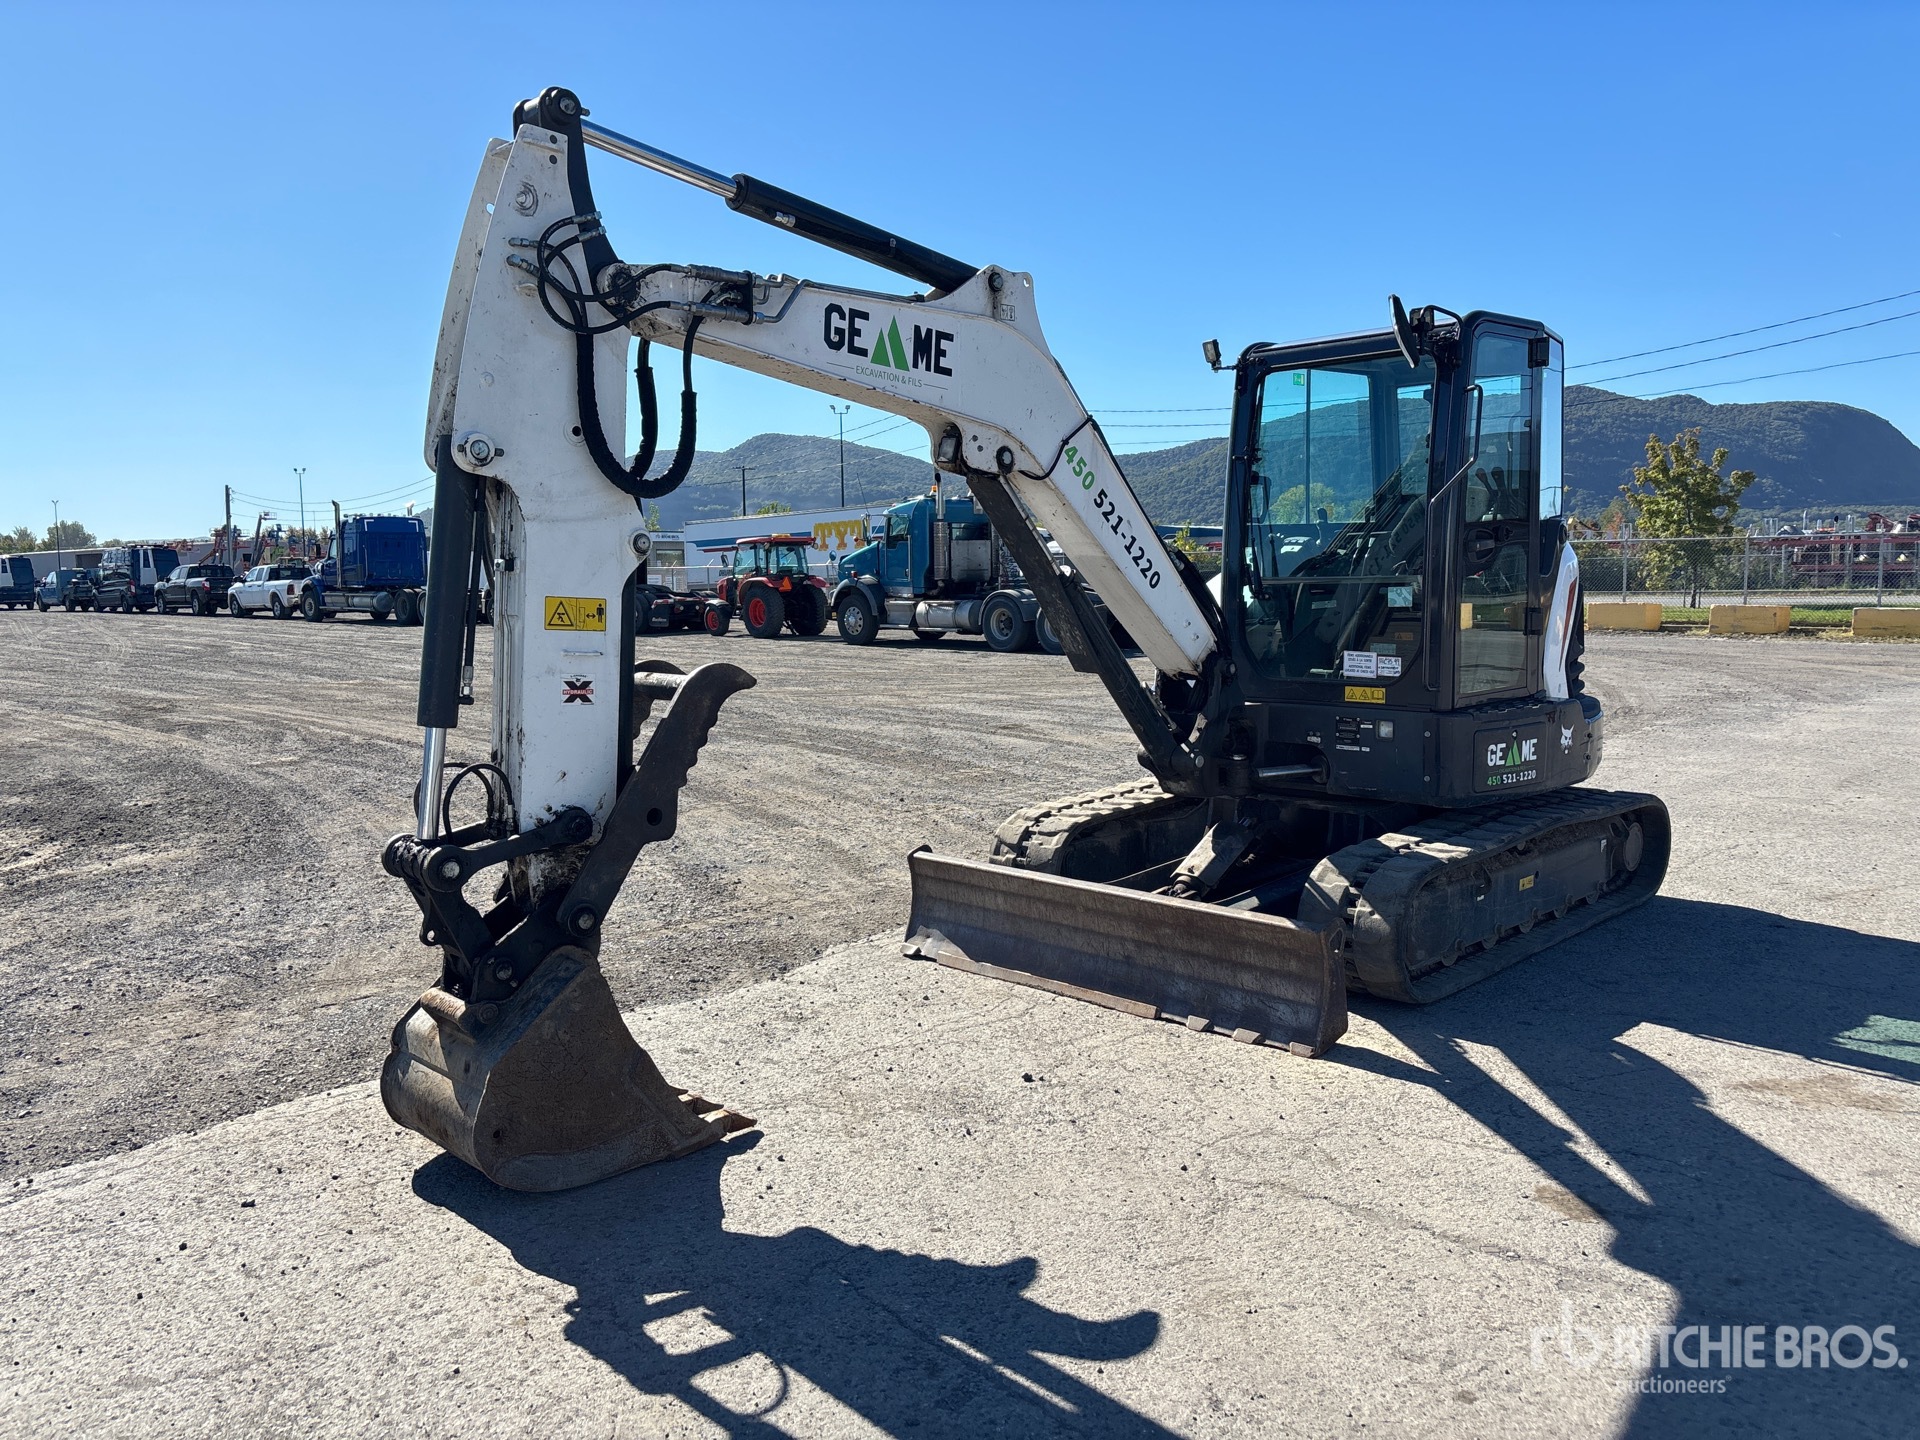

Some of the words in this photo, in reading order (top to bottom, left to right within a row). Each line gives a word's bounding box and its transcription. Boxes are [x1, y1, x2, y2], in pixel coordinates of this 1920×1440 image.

[855, 365, 900, 383] EXCAVATION
[900, 375, 907, 384] &
[907, 377, 923, 388] FILS
[1064, 446, 1095, 490] 450
[1093, 488, 1161, 590] 521-1220
[1487, 775, 1501, 786] 450
[1502, 770, 1537, 784] 521-1220
